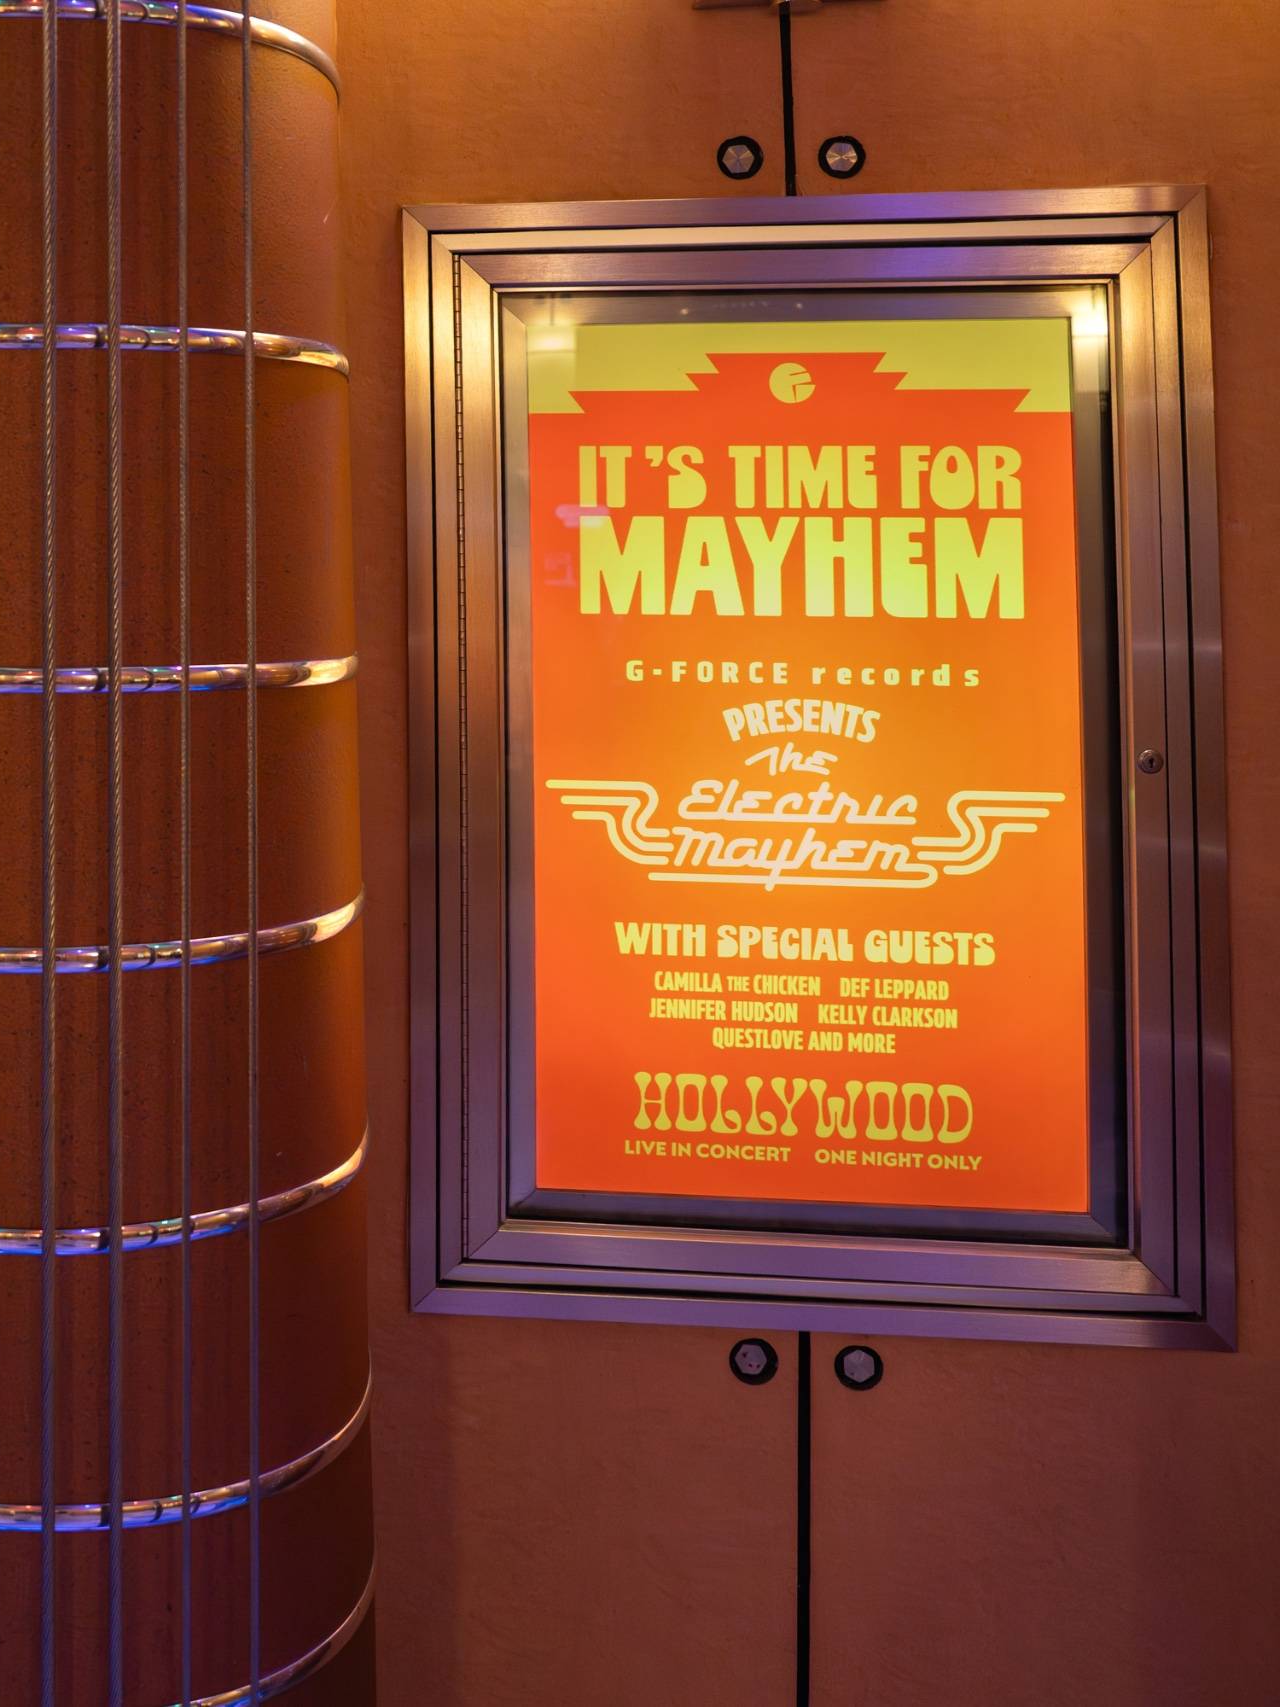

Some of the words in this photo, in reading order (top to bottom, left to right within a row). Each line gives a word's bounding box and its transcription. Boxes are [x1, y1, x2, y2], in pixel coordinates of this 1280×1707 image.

[728, 445, 878, 509] TIME
[900, 445, 1022, 510] FOR
[579, 515, 1025, 619] MAYHEM
[625, 660, 788, 685] G-FORCE
[811, 664, 980, 687] records
[722, 698, 880, 743] PRESENTS
[744, 742, 837, 775] The
[678, 778, 917, 825] Electric
[614, 922, 706, 957] WITH
[717, 924, 854, 962] SPECIAL
[864, 930, 996, 966] GUESTS
[654, 971, 722, 993] CAMILLA
[727, 975, 750, 992] THE
[753, 974, 821, 996] CHICKEN
[840, 977, 870, 998] DEF
[874, 978, 950, 1001] LEPPARD
[649, 998, 727, 1021] JENNIFER
[731, 1001, 798, 1024] HUDSON
[818, 1003, 867, 1026] KELLY
[872, 1006, 958, 1029] CLARKSON
[712, 1027, 804, 1051] QUESTLOVE
[808, 1032, 843, 1052] AND
[848, 1033, 896, 1054] MORE
[633, 1071, 974, 1144] HOLLYWOOD
[624, 1139, 667, 1157] LIVE
[671, 1142, 691, 1158] IN
[695, 1143, 791, 1163] CONCERT
[814, 1148, 858, 1166] ONE
[862, 1151, 924, 1169] NIGHT
[927, 1153, 983, 1172] ONLY
